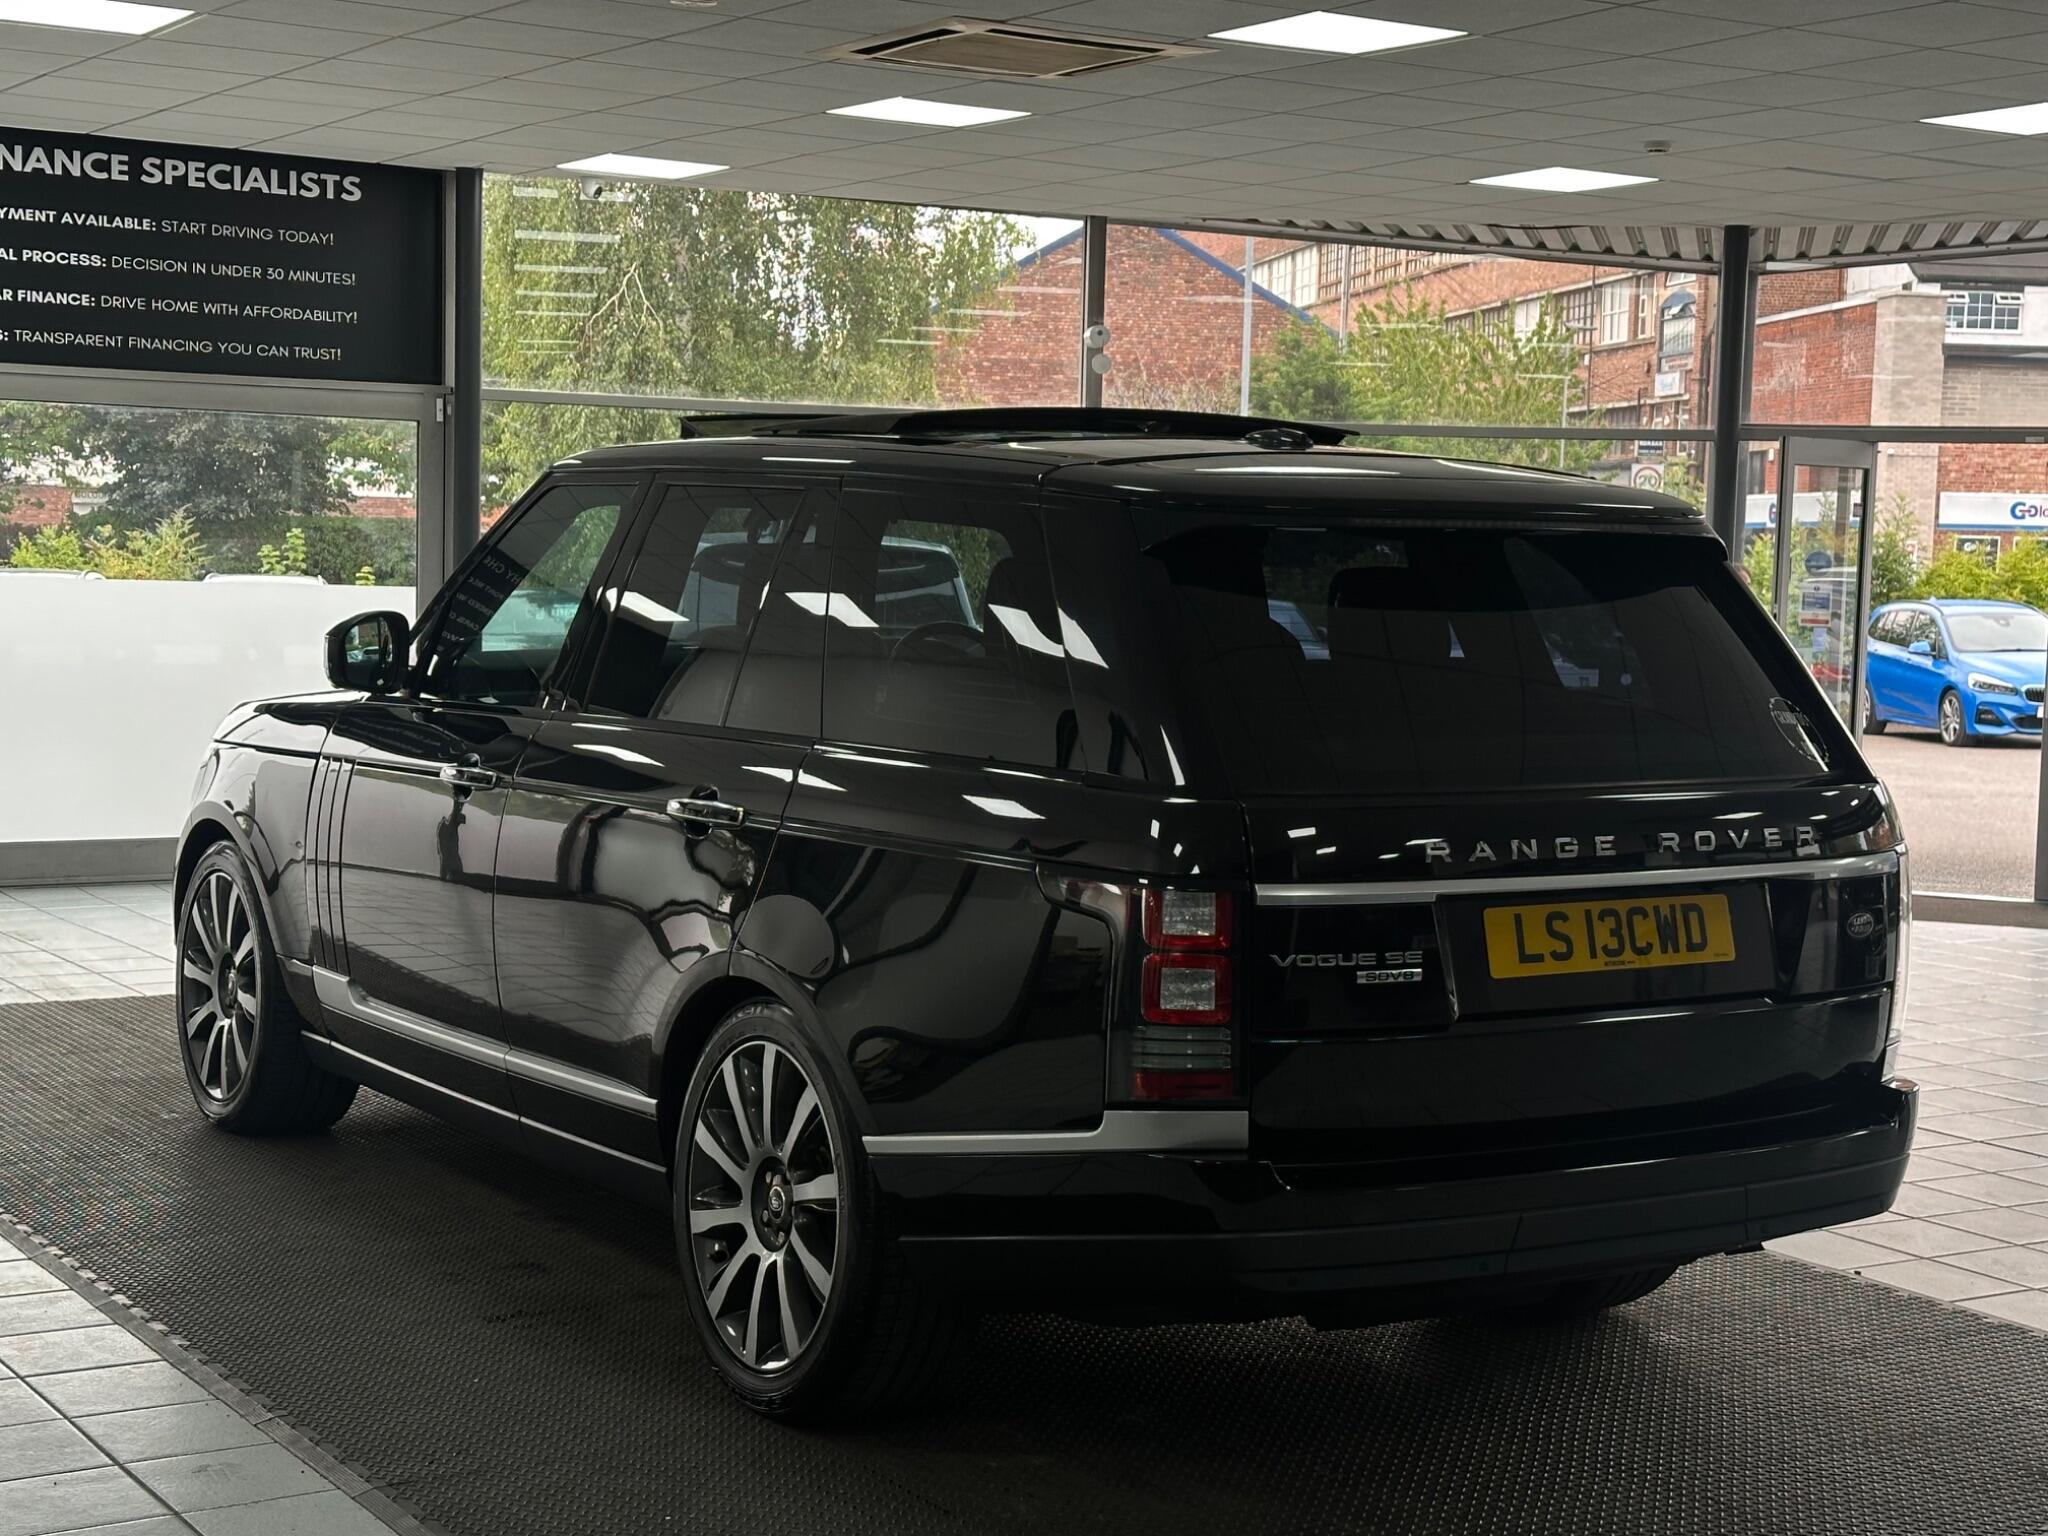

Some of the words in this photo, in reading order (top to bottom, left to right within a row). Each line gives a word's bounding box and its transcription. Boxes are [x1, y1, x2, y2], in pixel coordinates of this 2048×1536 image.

[0, 143, 129, 181] NANCE
[140, 157, 362, 201] SPECIALISTS
[0, 207, 56, 223] YMENT
[61, 212, 156, 231] AVAILABLE:
[161, 219, 207, 235] START
[211, 223, 273, 241] DRIVING
[278, 229, 334, 245] TODAY!
[0, 248, 18, 261] AL
[22, 249, 107, 267] PROCESS:
[111, 255, 187, 273] DECISION
[192, 261, 206, 275] IN
[211, 263, 262, 279] UNDER
[266, 267, 284, 280] 30
[288, 270, 356, 286] MINUTES!
[0, 288, 13, 301] R
[17, 289, 95, 307] FINANCE:
[101, 295, 146, 310] DRIVE
[152, 299, 199, 314] HOME
[203, 302, 239, 316] WITH
[243, 305, 357, 324] AFFORDABILITY!
[14, 329, 123, 348] TRANSPARENT
[128, 336, 213, 354] FINANCING
[218, 341, 252, 356] YOU
[256, 344, 289, 358] CAN
[293, 346, 341, 361] TRUST!
[1425, 835, 1615, 863] RANGE
[1659, 826, 1818, 854] ROVER
[1269, 953, 1376, 967] VOGUE
[1384, 951, 1423, 964] SE
[1365, 971, 1414, 984] SDV8
